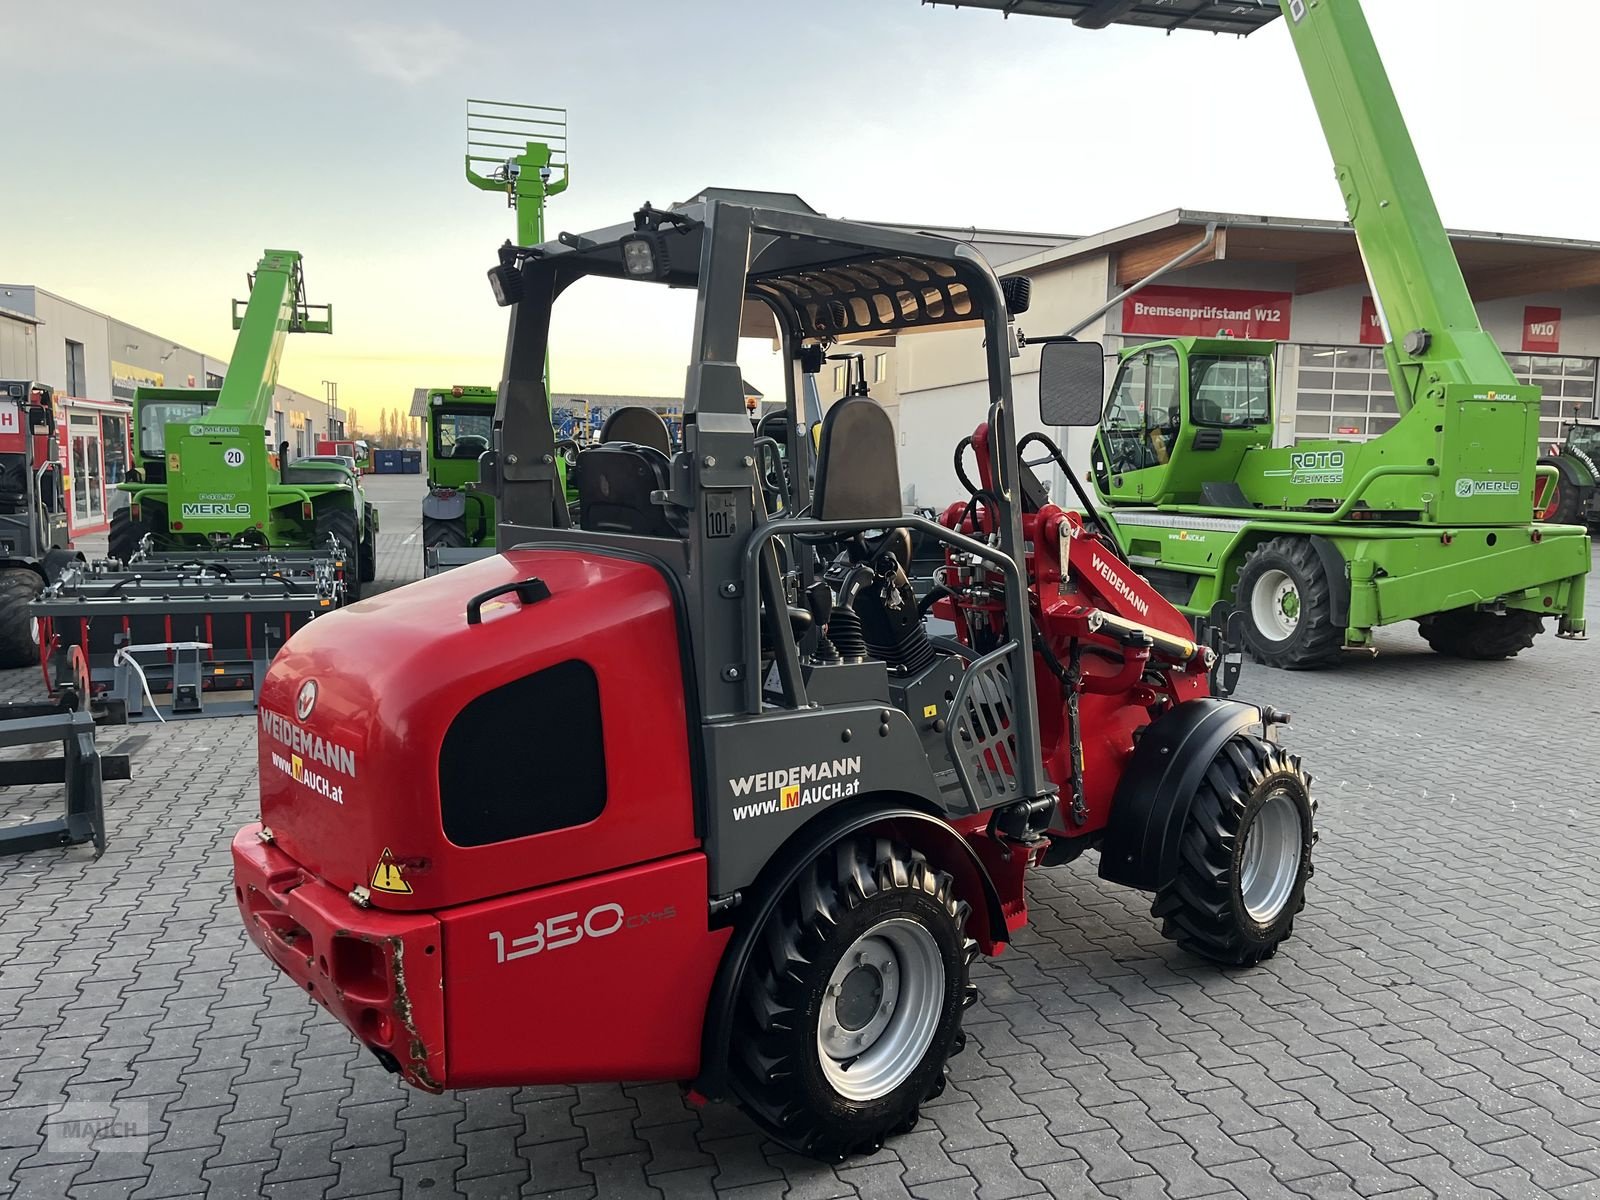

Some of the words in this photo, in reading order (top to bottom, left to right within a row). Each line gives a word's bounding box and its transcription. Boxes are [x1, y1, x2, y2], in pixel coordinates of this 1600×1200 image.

[1134, 302, 1251, 321] Bremsenprüfstand
[1255, 309, 1281, 322] W12
[1531, 323, 1554, 336] W10
[227, 451, 242, 463] 20
[1291, 451, 1344, 468] ROTO
[1475, 481, 1519, 491] MERLO
[183, 503, 250, 514] MERLO
[709, 512, 728, 535] 101
[1091, 552, 1149, 617] WEIDEMANN
[260, 706, 355, 778] WEIDEMANN
[272, 752, 343, 805] www.MAUCH.at
[729, 756, 861, 797] WEIDEMANN
[733, 778, 860, 821] www.MAUCH.at
[489, 902, 624, 963] 1350
